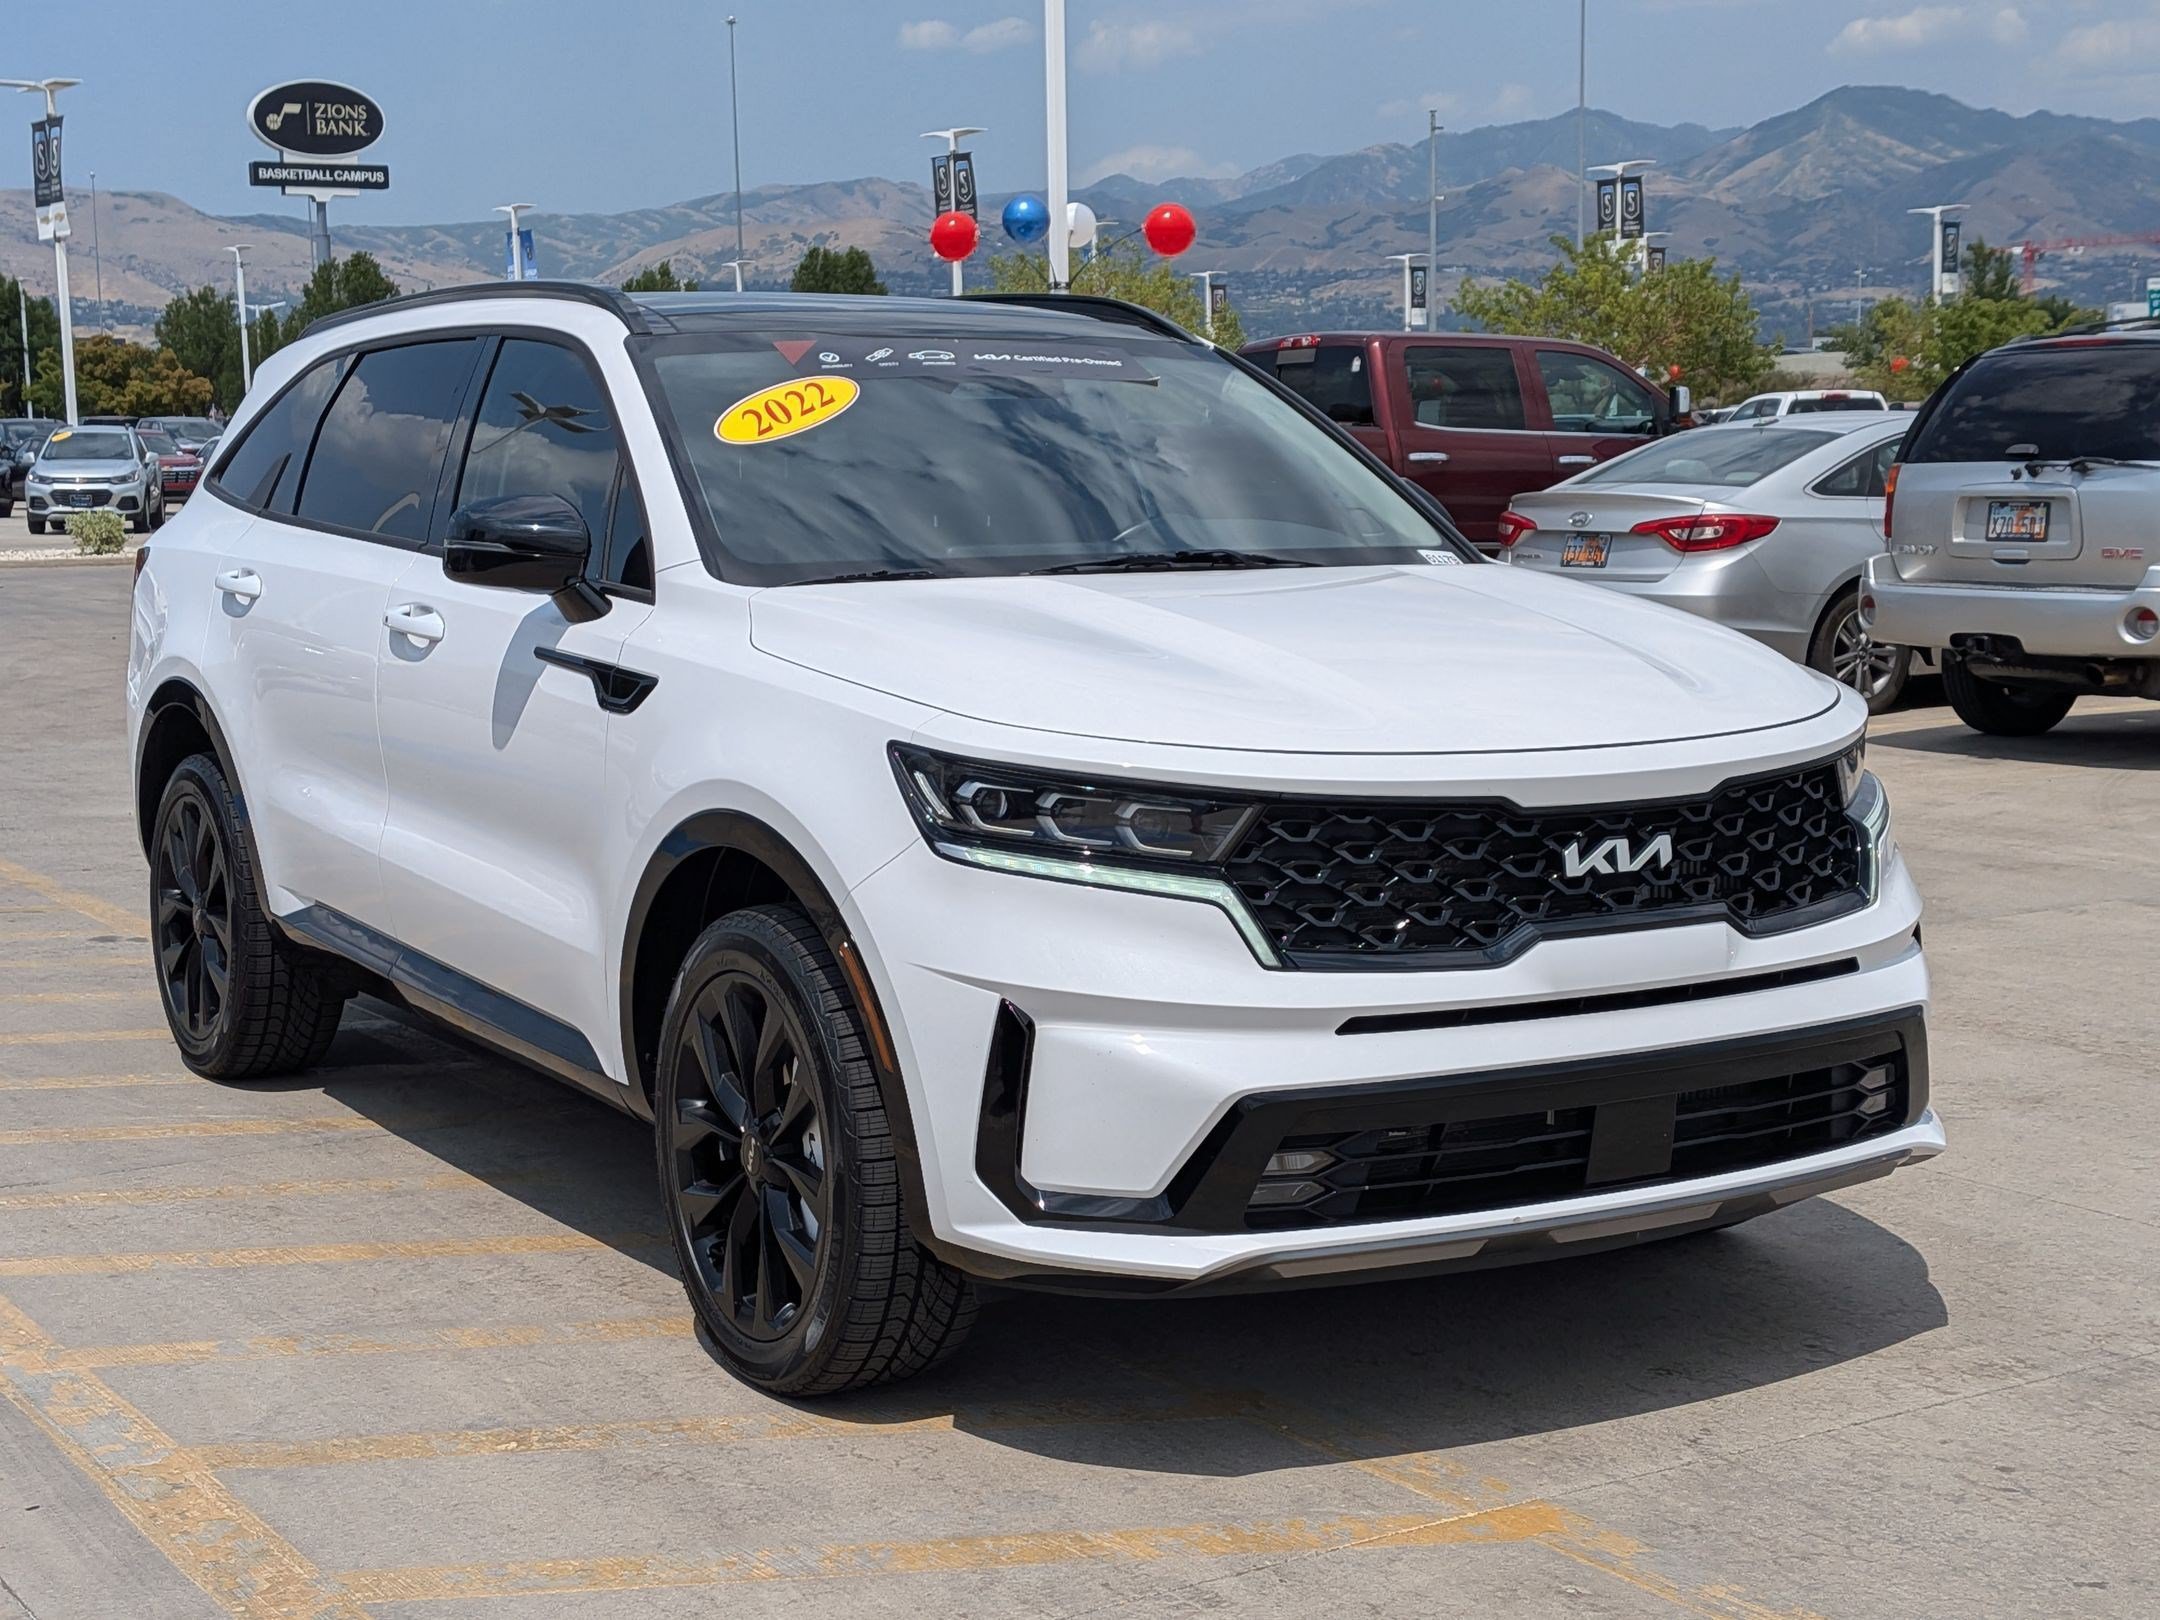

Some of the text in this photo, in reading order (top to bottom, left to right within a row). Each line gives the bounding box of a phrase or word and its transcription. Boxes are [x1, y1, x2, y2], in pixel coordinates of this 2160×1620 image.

[314, 102, 367, 120] ZIONS
[315, 119, 368, 136] BANK
[258, 167, 385, 183] BASKETBALL CAMPUS
[1013, 354, 1061, 363] Certified
[1061, 356, 1123, 367] Pre-Owned
[741, 382, 836, 437] 2022
[2101, 546, 2145, 561] GMC
[1564, 834, 1673, 878] KIA
